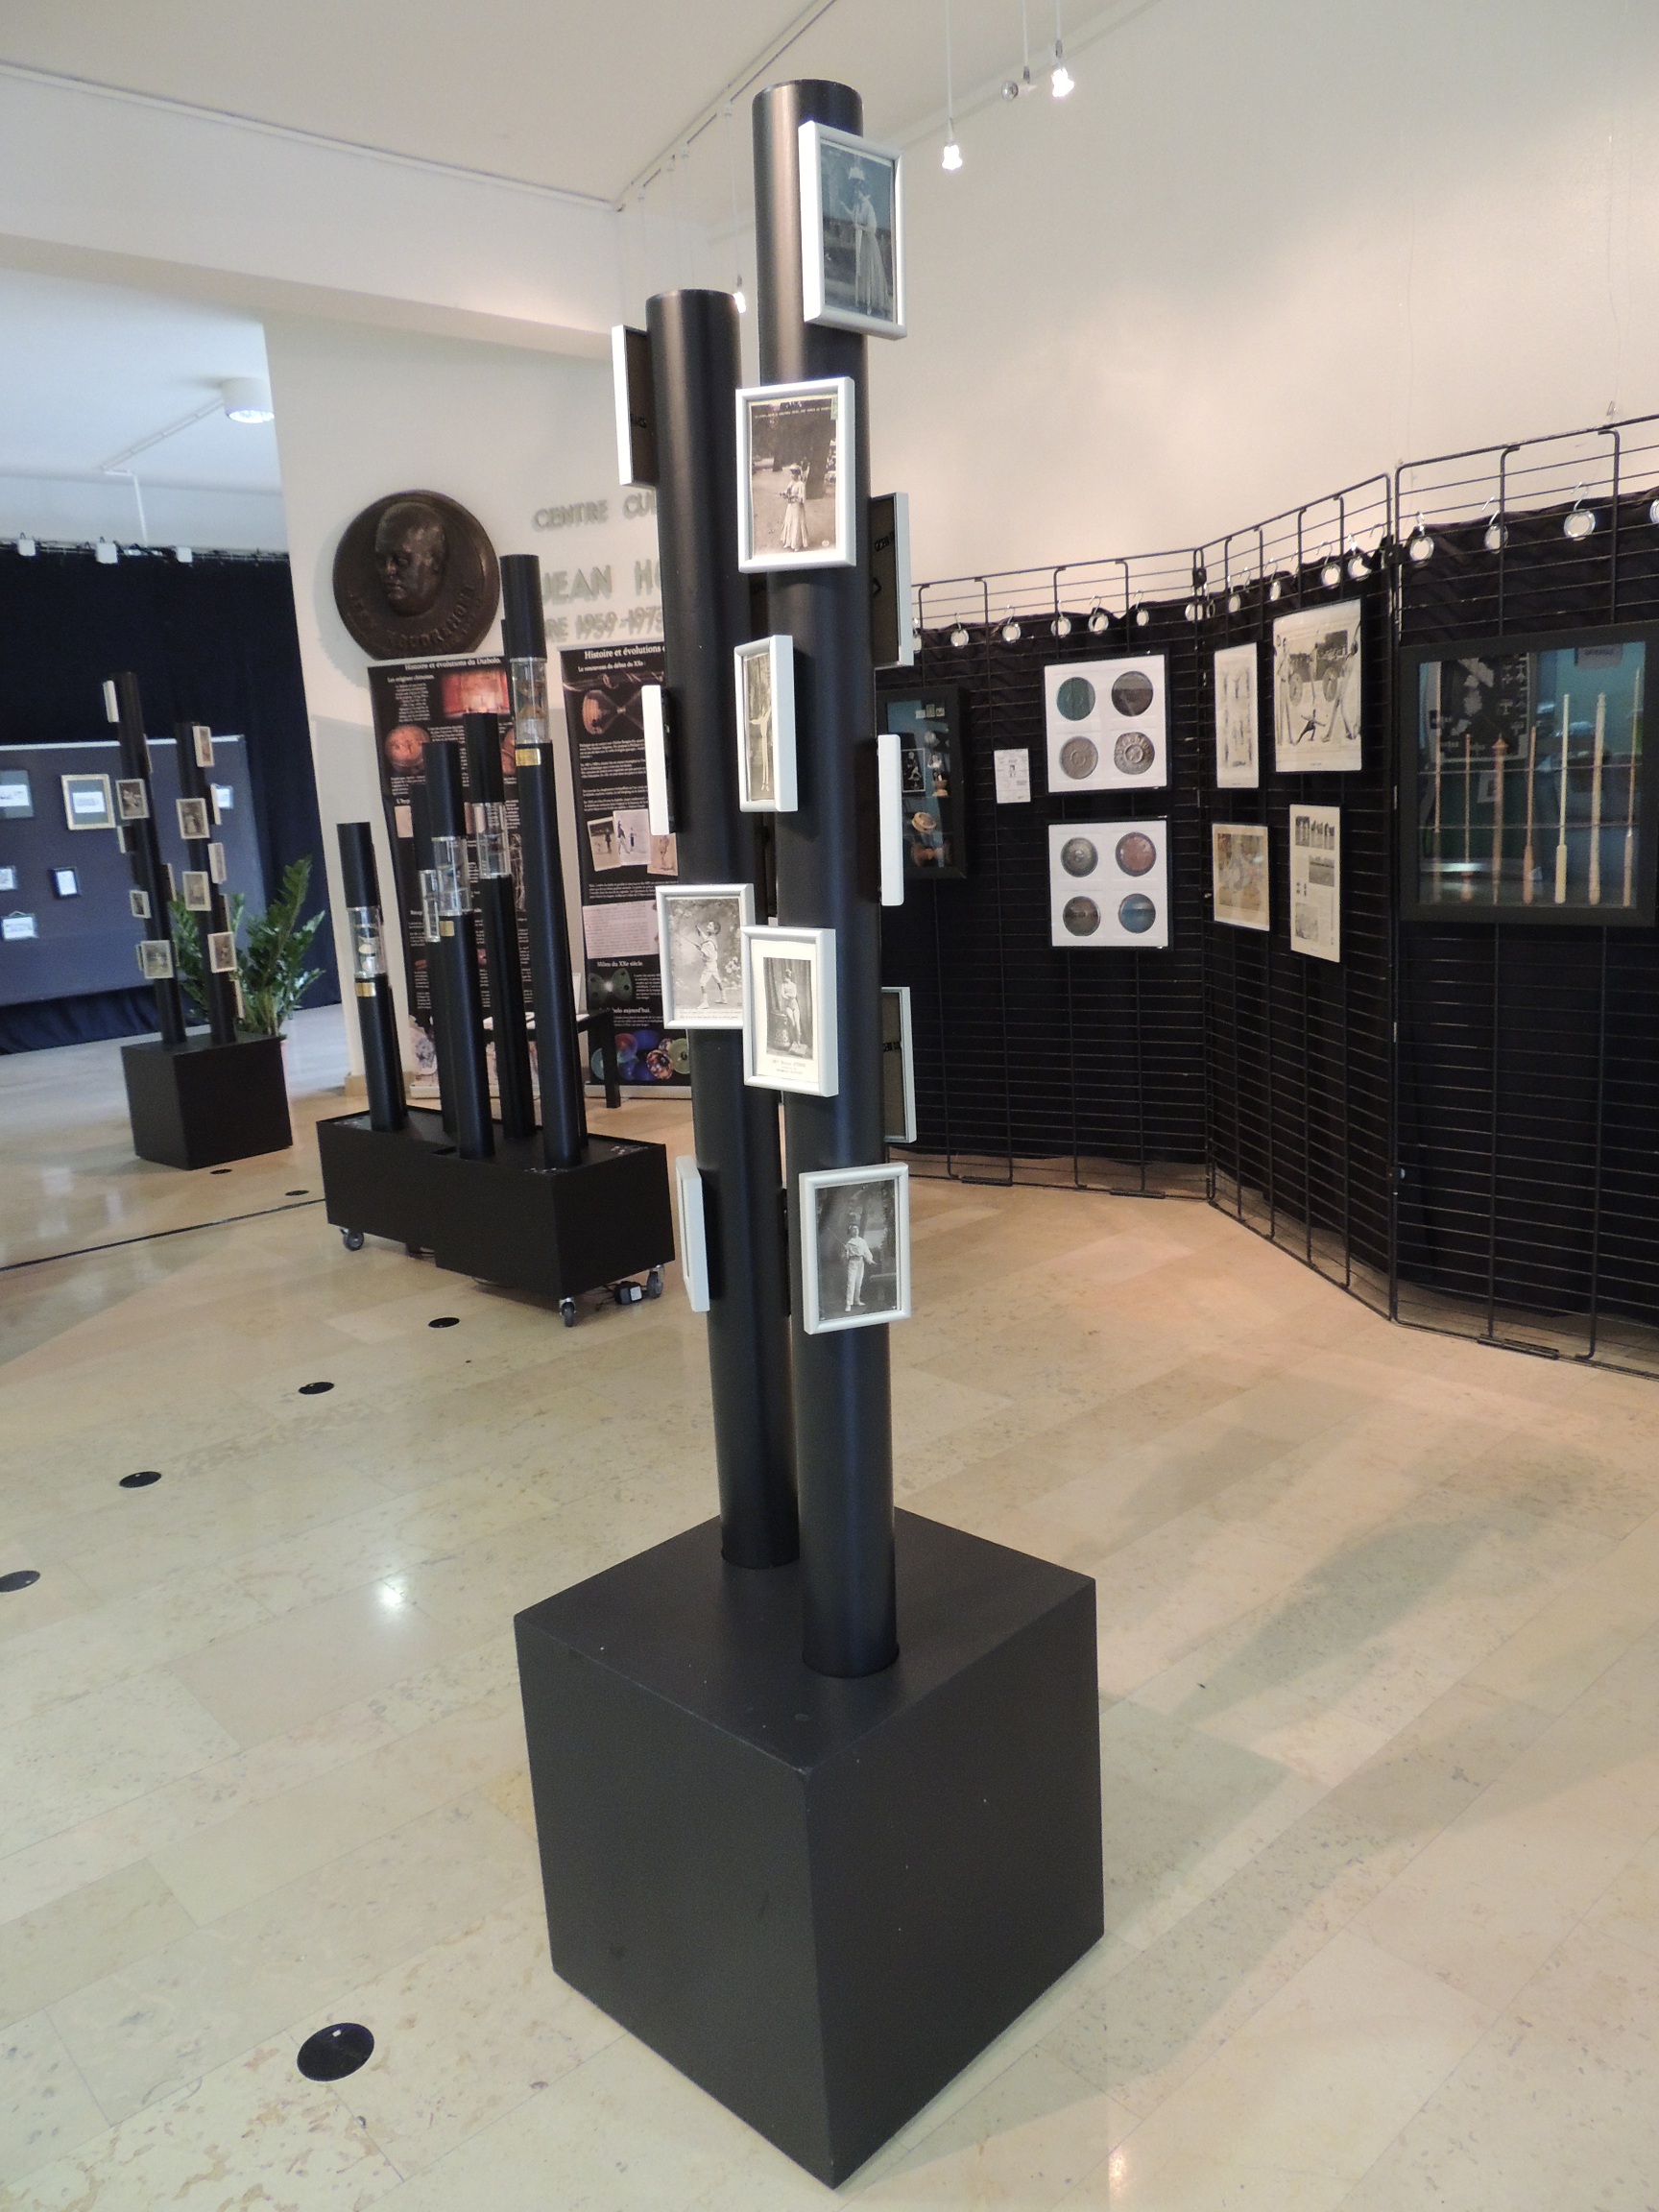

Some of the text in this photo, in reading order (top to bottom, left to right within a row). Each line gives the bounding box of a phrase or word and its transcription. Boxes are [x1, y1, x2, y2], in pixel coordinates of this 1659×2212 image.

[533, 499, 609, 532] CENTRE
[541, 564, 613, 606] JEAN
[584, 649, 613, 660] Histoire
[623, 645, 661, 656] évolutions
[405, 662, 428, 671] Histoire
